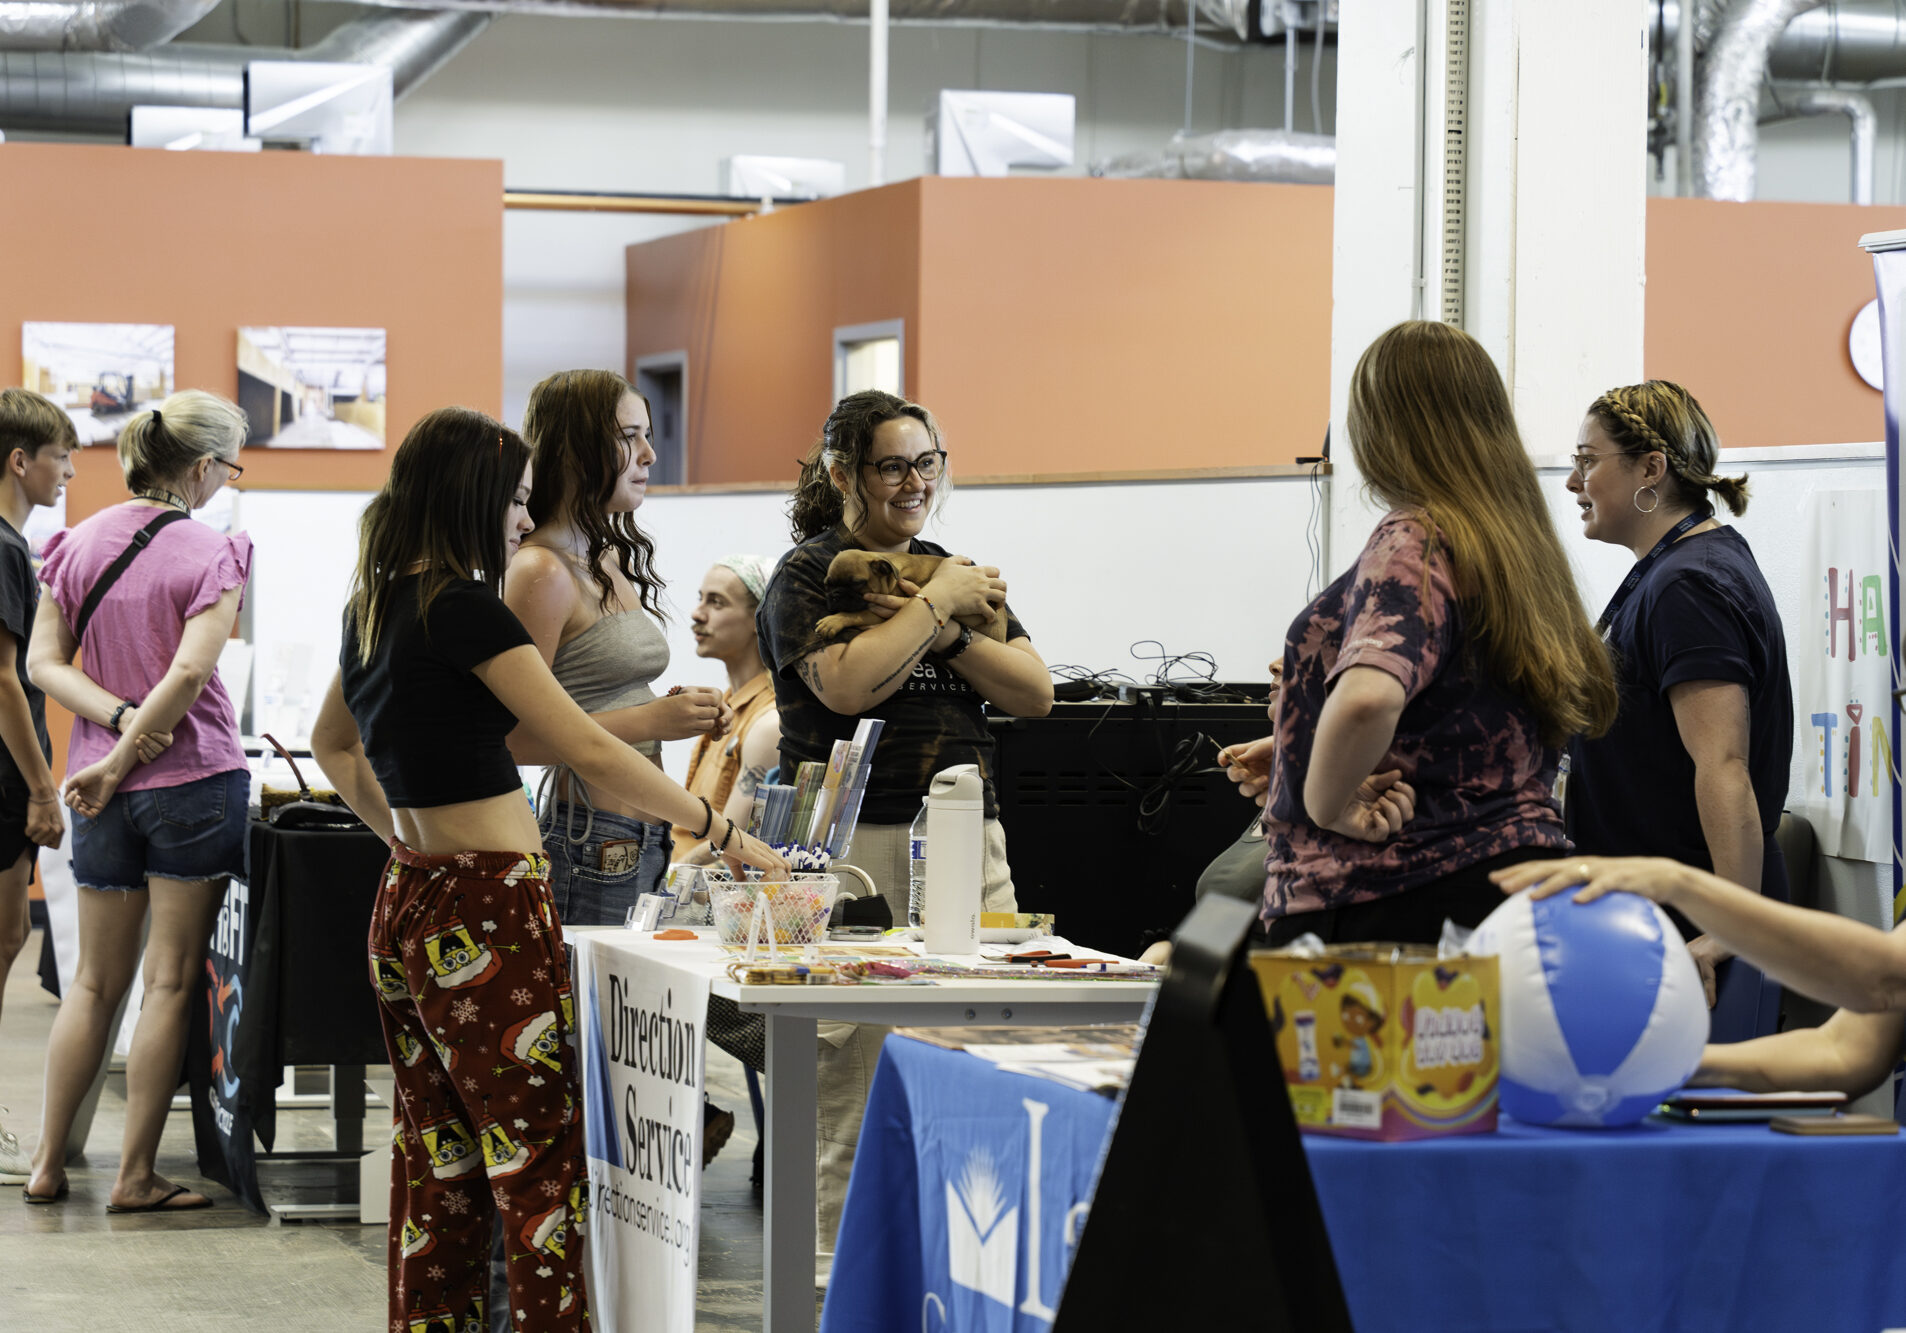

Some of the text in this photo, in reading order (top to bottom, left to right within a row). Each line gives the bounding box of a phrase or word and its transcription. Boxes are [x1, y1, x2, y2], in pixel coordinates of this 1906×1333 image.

[898, 682, 975, 692] ERVICE
[608, 973, 696, 1088] Direction
[625, 1083, 692, 1198] Service
